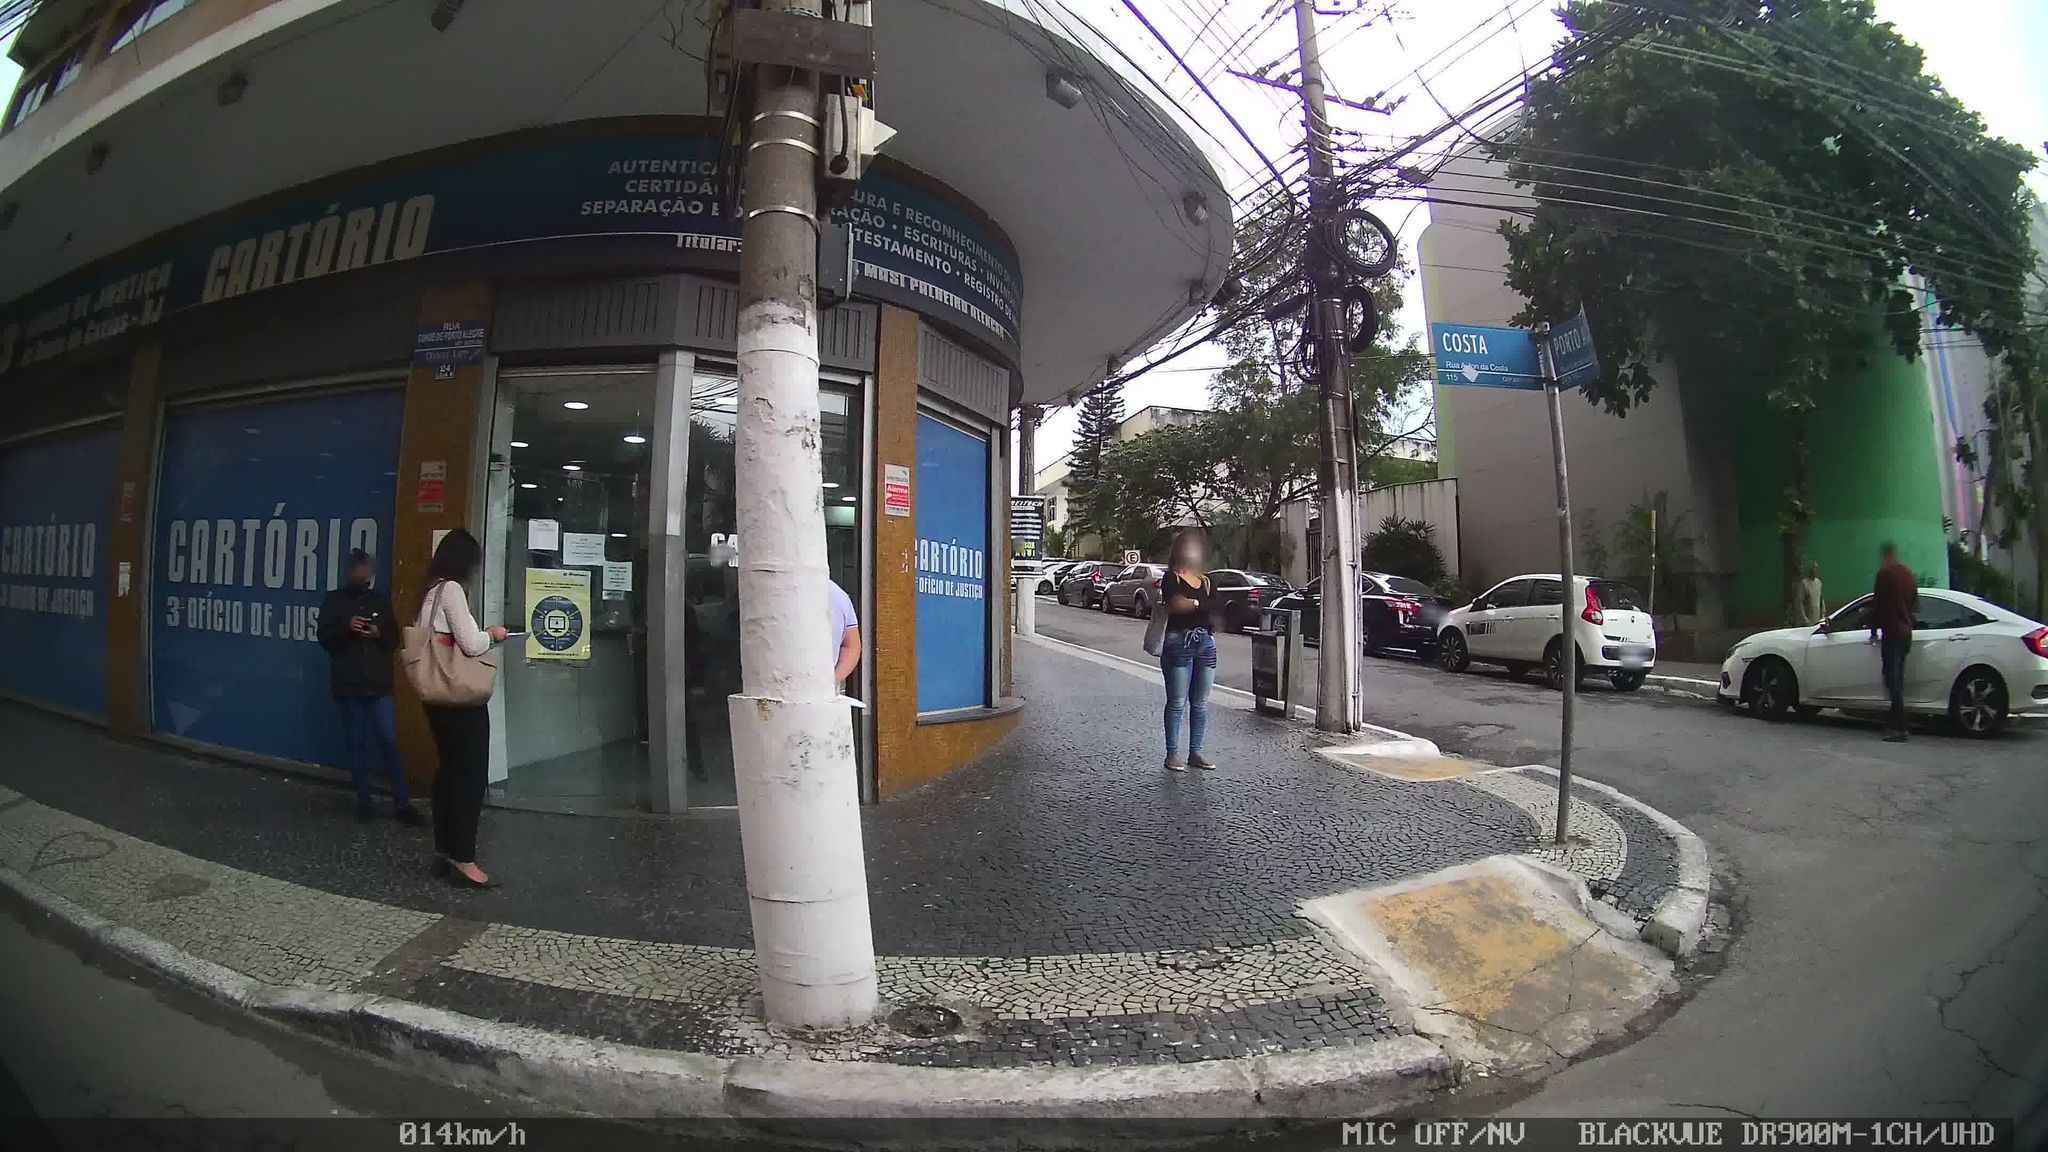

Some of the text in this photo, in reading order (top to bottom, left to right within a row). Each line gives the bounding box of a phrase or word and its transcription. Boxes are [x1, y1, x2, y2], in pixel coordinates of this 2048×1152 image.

[580, 196, 703, 217] SEPARAÇÃO
[892, 202, 901, 217] E
[202, 193, 435, 304] CARTÓRIO
[903, 225, 977, 273] ESCRITURAS
[854, 227, 952, 276] TESTAMENTO
[964, 271, 1004, 311] REGISTRO
[443, 322, 461, 331] RUA
[1442, 332, 1489, 355] COSTA
[1553, 328, 1581, 359] PORTO
[1446, 361, 1460, 369] Rua
[1490, 363, 1509, 372] Costa
[1446, 373, 1459, 381] 115
[2, 512, 96, 578] CARTÓRIO
[168, 502, 378, 592] CARTÓRIO
[914, 538, 983, 579] ARTÓRIO
[919, 575, 983, 601] OFÍCIO DE JUSTIÇA
[187, 590, 243, 634] OFÍCIO
[250, 602, 273, 637] DE
